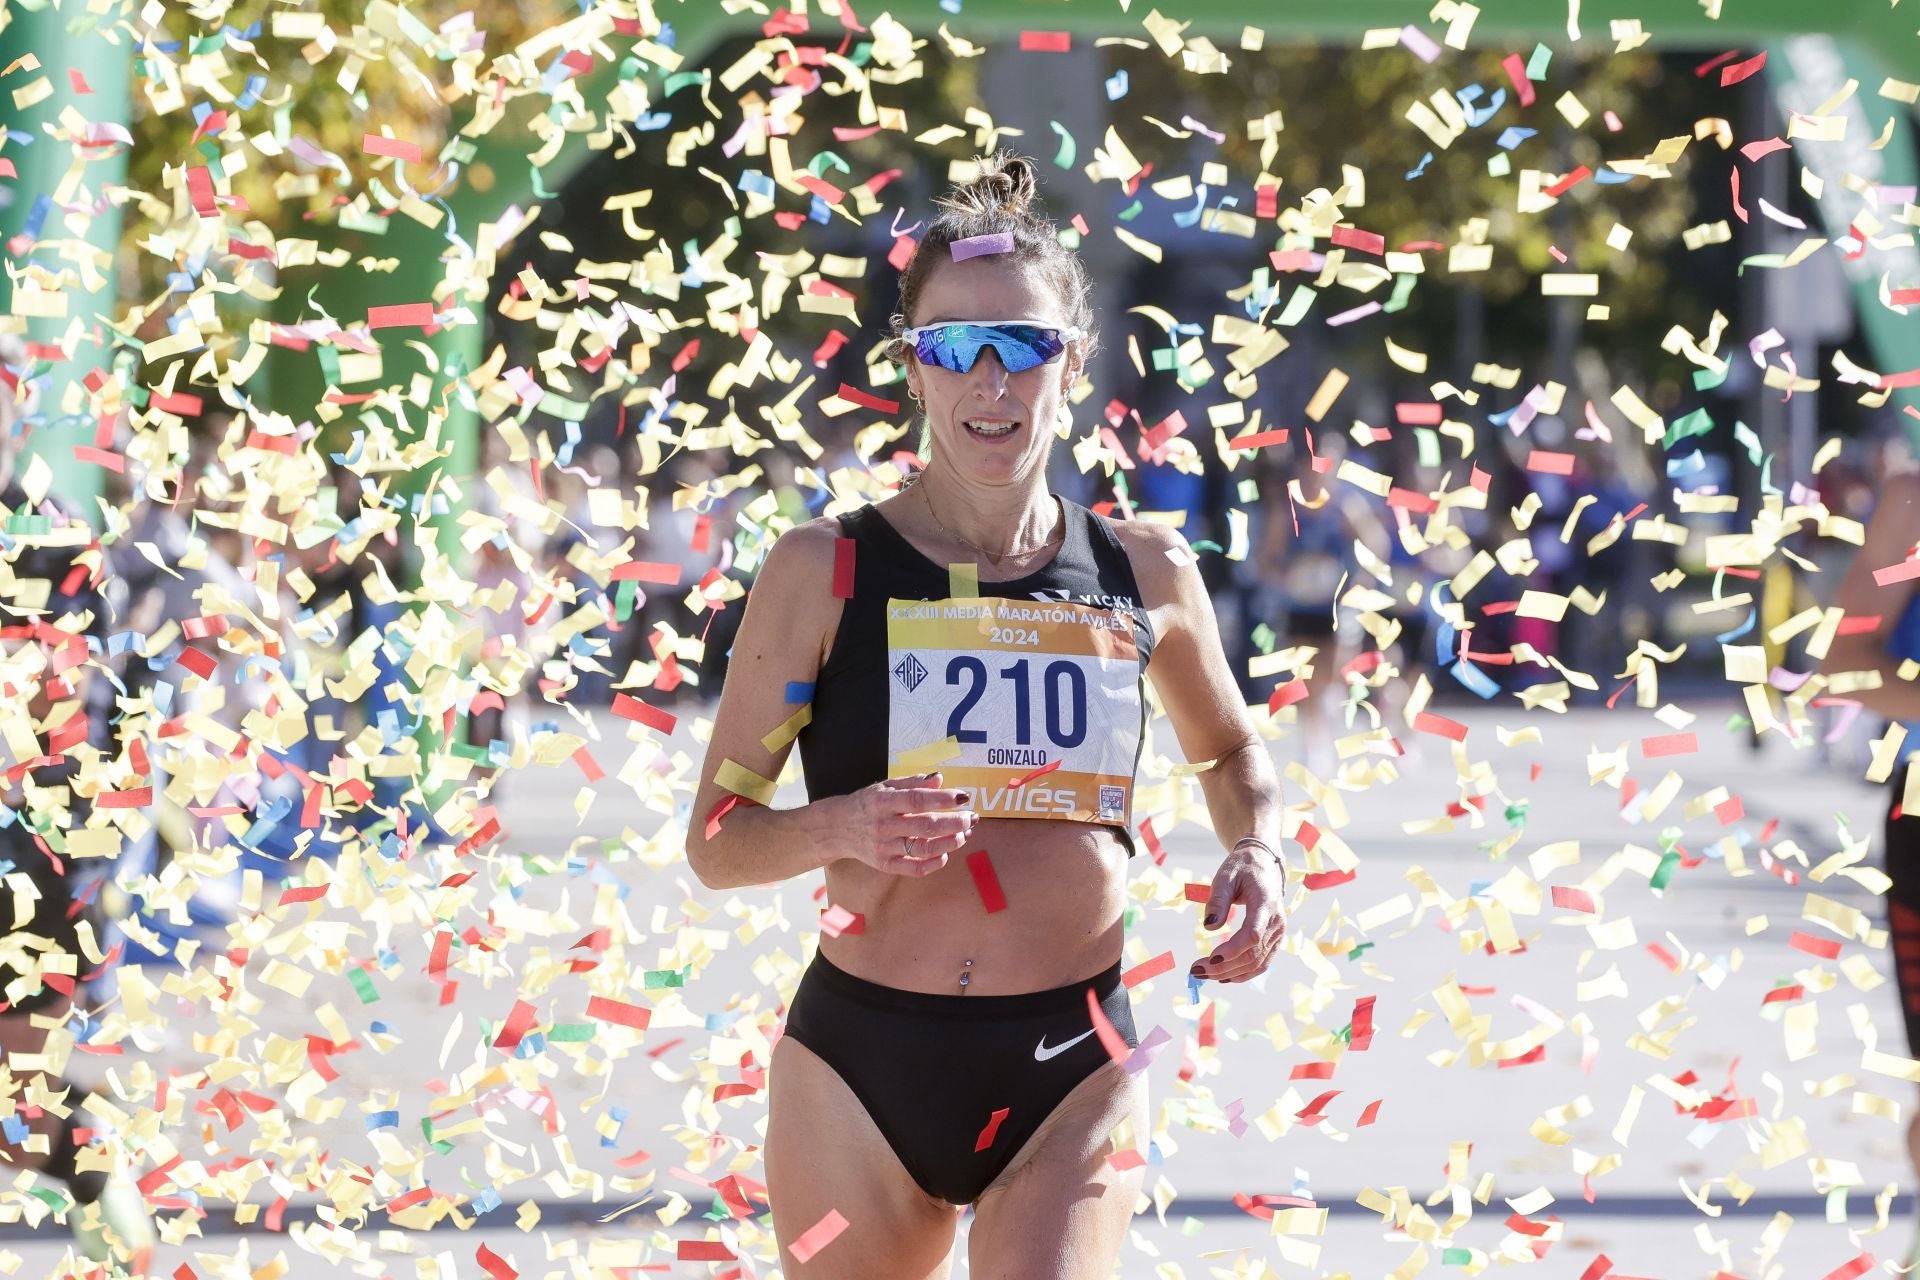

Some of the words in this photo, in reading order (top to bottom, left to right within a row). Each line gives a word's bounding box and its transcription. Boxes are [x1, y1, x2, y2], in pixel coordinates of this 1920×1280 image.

[1079, 594, 1133, 609] VICKY
[943, 606, 993, 619] MEDIA
[998, 606, 1076, 624] MARATÓN
[989, 628, 1040, 646] 2024
[945, 655, 1087, 749] 210
[987, 748, 1047, 766] GONZALO
